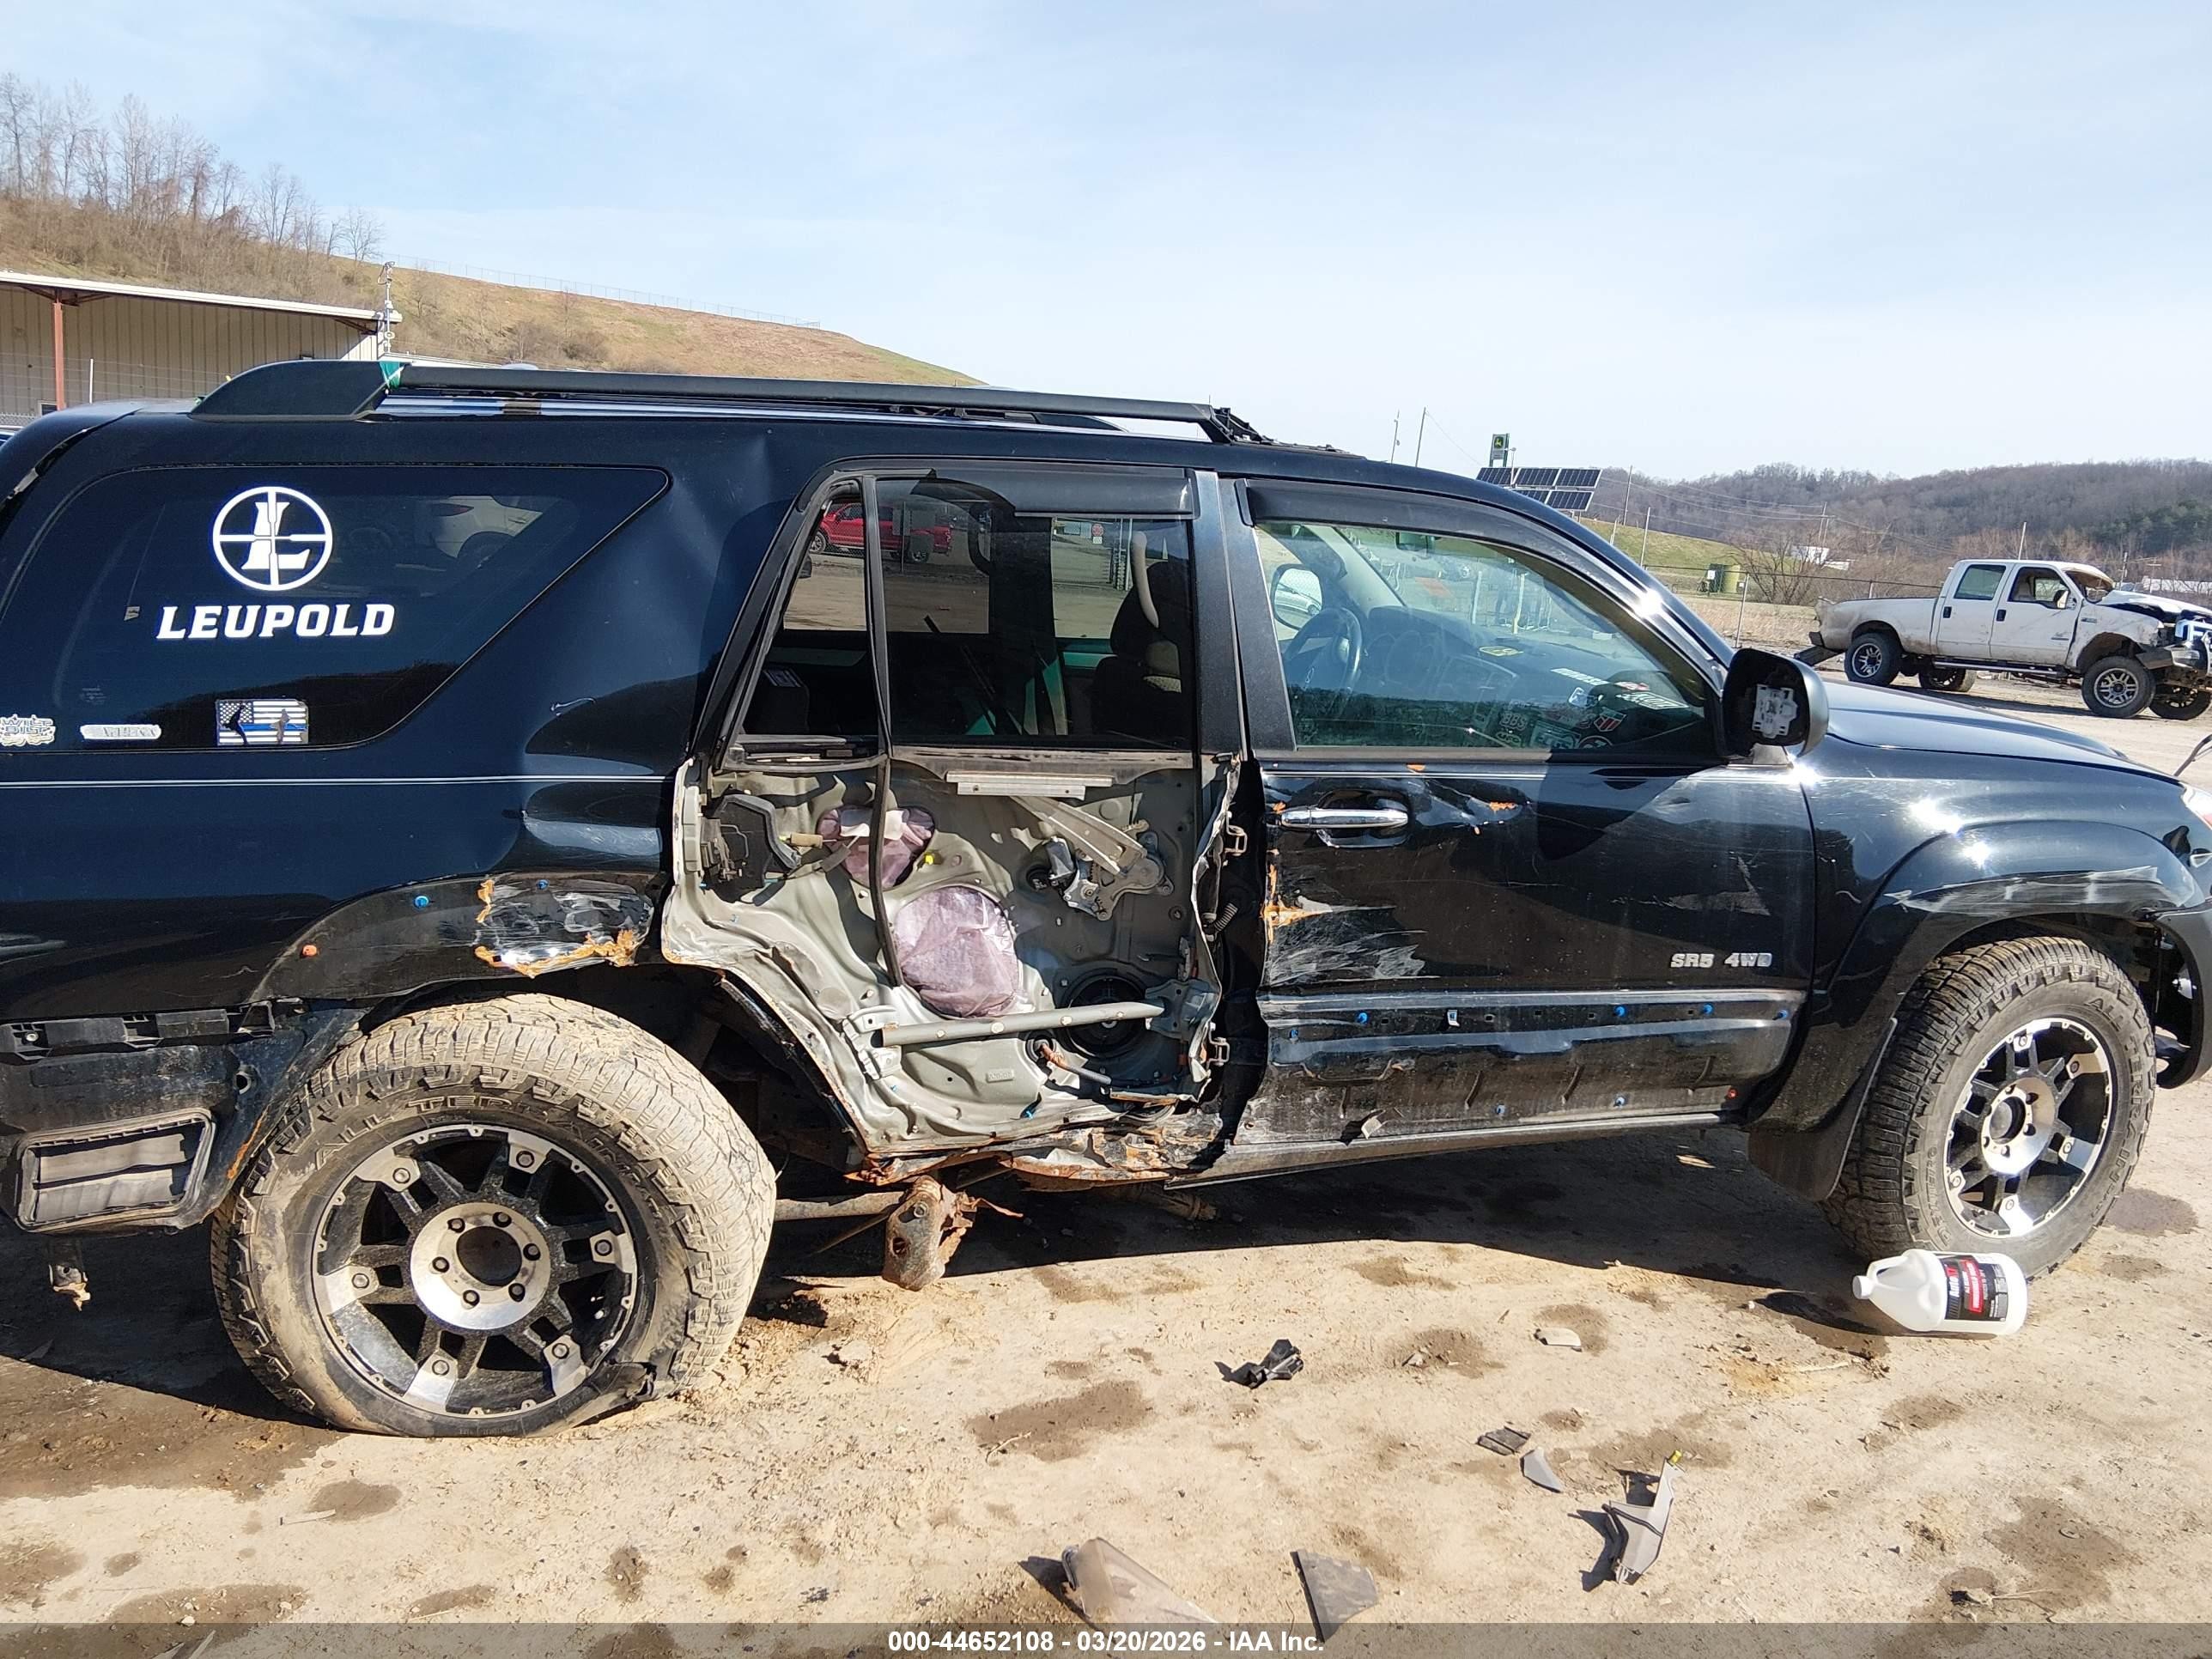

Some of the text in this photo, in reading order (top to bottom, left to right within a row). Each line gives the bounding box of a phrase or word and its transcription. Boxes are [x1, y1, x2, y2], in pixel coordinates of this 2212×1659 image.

[241, 501, 311, 569] L
[156, 604, 395, 639] LEUPOLD
[1670, 952, 1772, 968] SR5 4WD
[2084, 997, 2124, 1032] ALL
[316, 1114, 395, 1170] ALL
